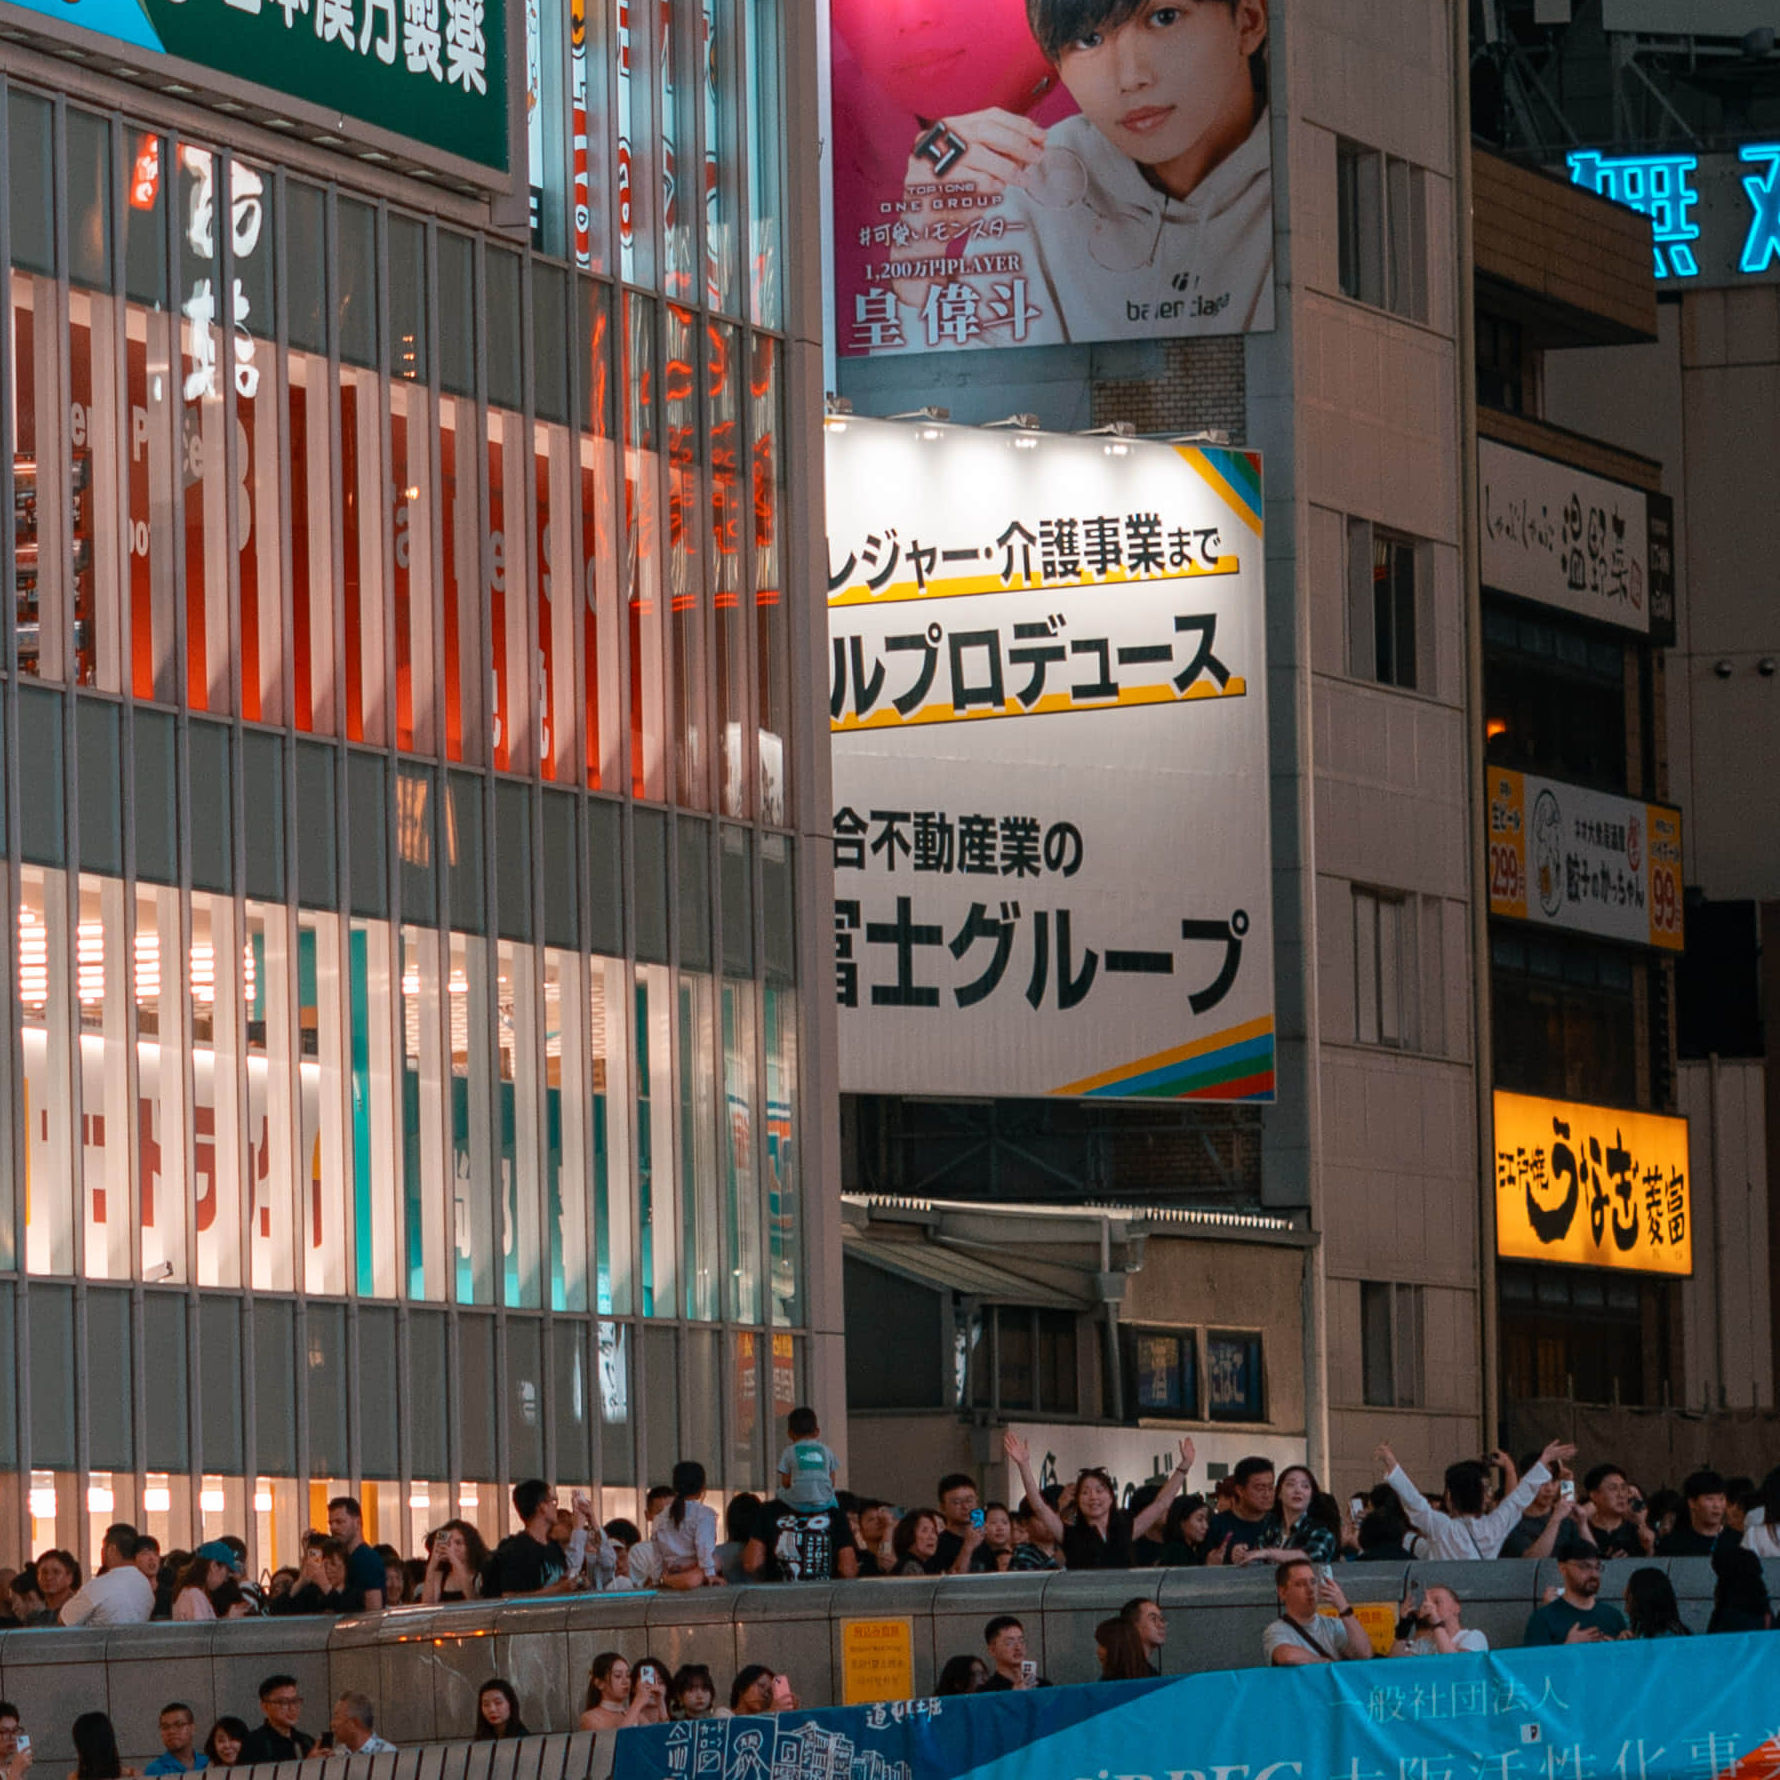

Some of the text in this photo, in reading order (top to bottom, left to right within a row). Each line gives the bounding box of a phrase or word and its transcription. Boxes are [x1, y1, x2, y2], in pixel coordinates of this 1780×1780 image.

[880, 194, 1004, 214] ONE GROUP
[1329, 1674, 1570, 1723] 一般社団法人
